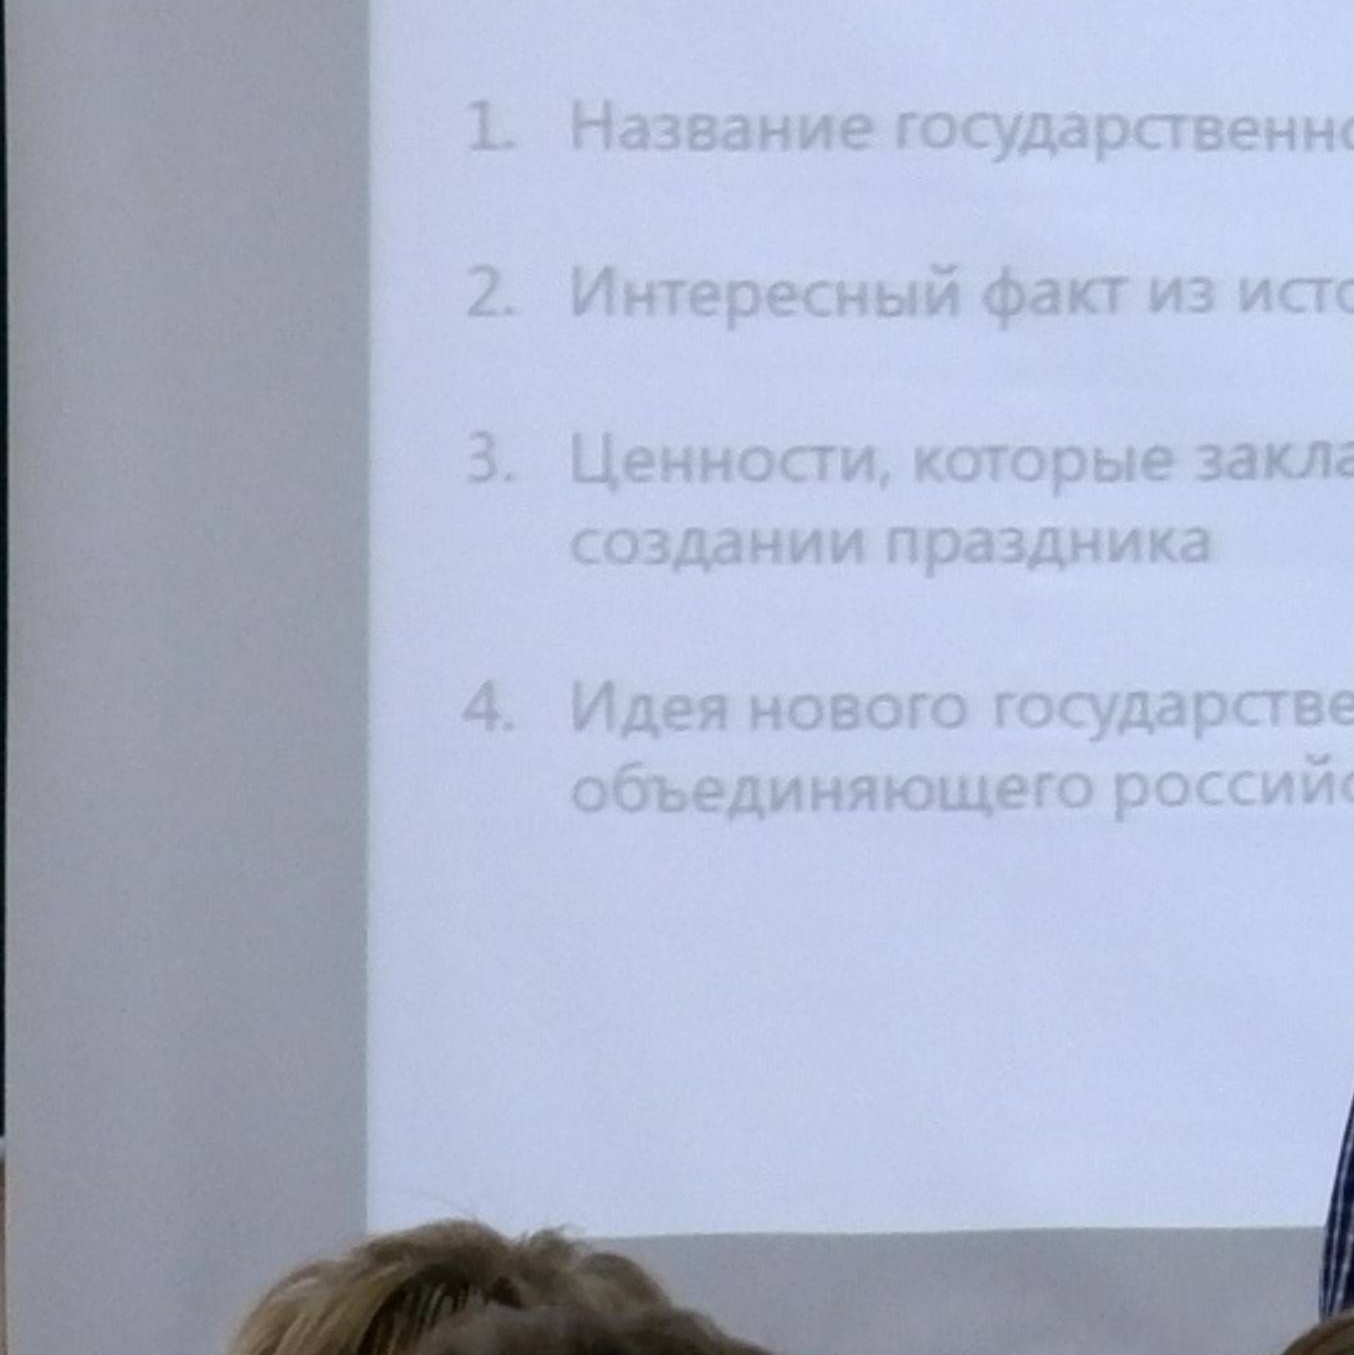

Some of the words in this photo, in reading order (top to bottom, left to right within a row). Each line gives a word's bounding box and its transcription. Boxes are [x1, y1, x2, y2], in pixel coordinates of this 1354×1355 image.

[469, 99, 516, 151] 1.
[572, 100, 876, 152] Название
[467, 264, 515, 317] 2.
[572, 263, 961, 331] Интересный
[982, 265, 1130, 330] факт
[1148, 276, 1216, 314] из
[468, 430, 515, 484] 3.
[572, 432, 890, 493] Ценности,
[915, 444, 1178, 497] которые
[570, 527, 866, 573] создании
[887, 526, 1212, 578] праздника
[462, 680, 514, 731] 4.
[572, 680, 728, 739] Идея
[750, 692, 969, 731] нового
[571, 761, 1095, 822] объединяющего
